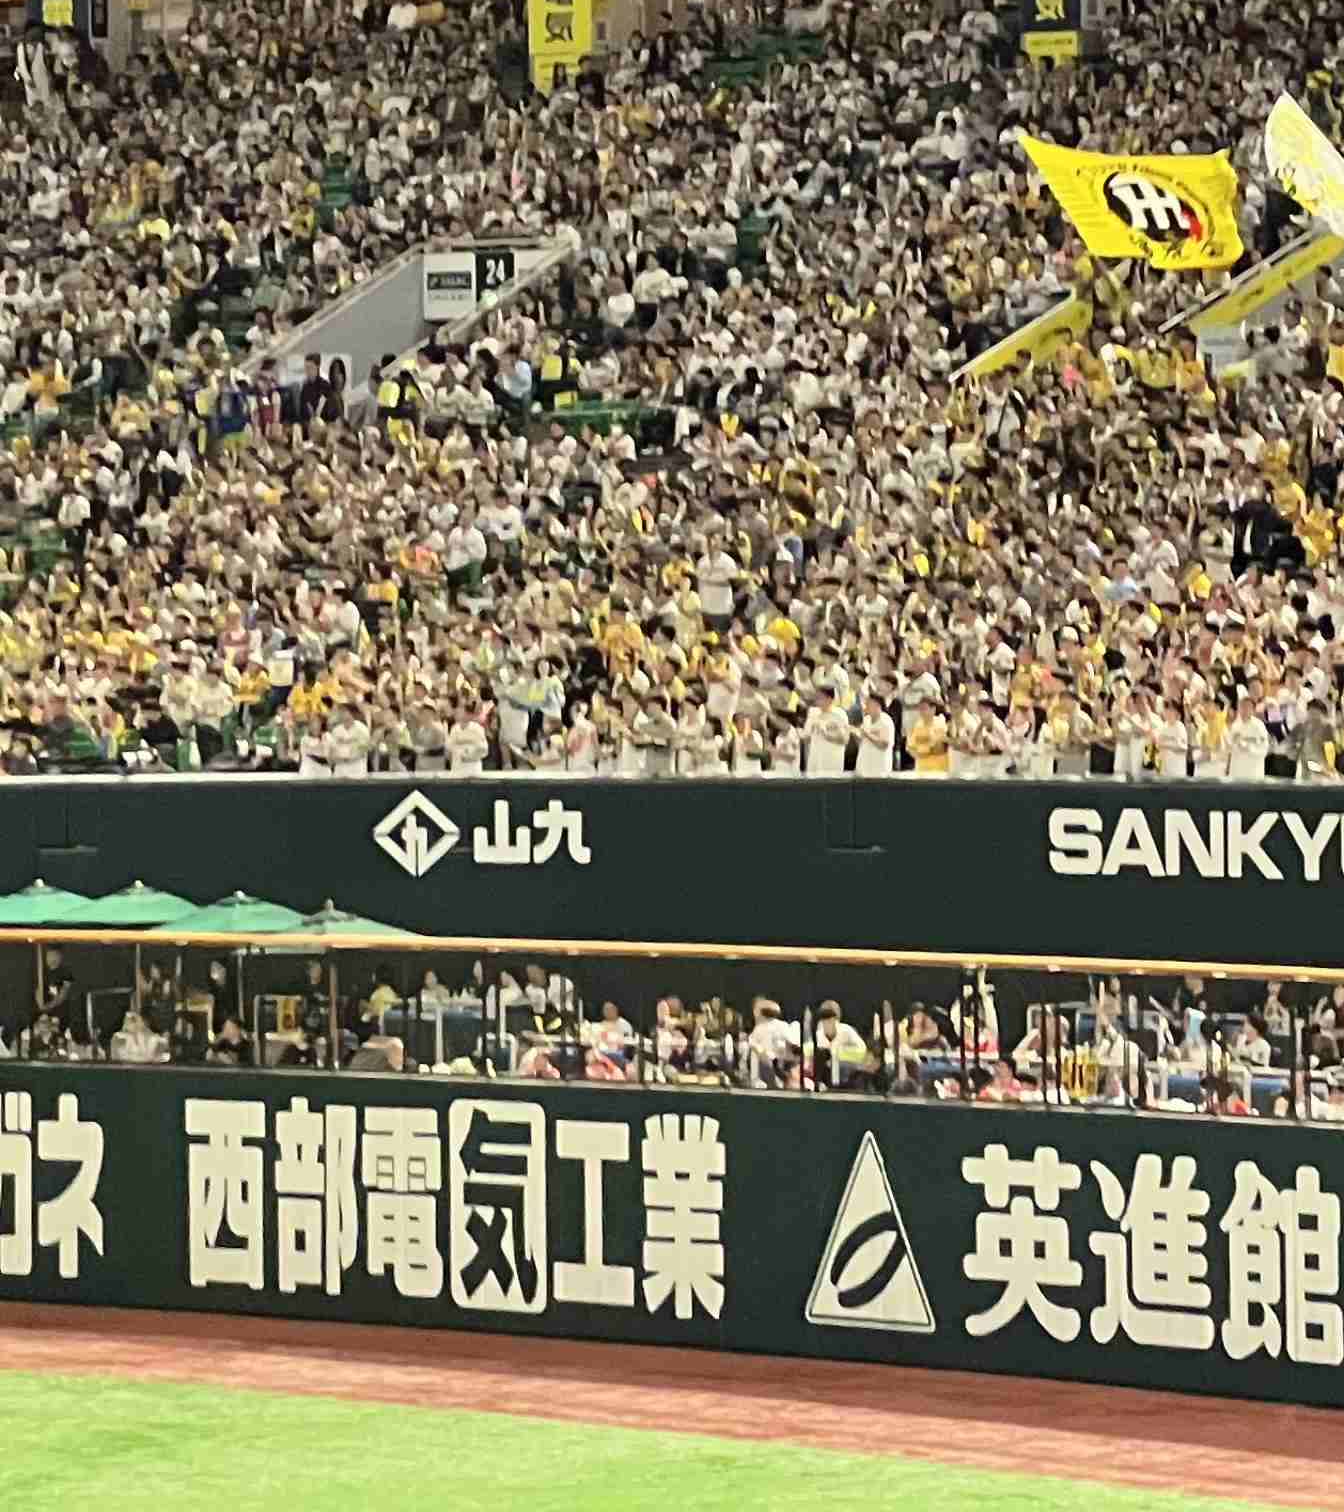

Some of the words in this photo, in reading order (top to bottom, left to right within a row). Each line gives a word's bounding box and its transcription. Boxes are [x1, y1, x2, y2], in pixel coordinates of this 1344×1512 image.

[486, 258, 505, 285] 24
[473, 799, 591, 864] 山九
[961, 1143, 1344, 1366] 英進館
